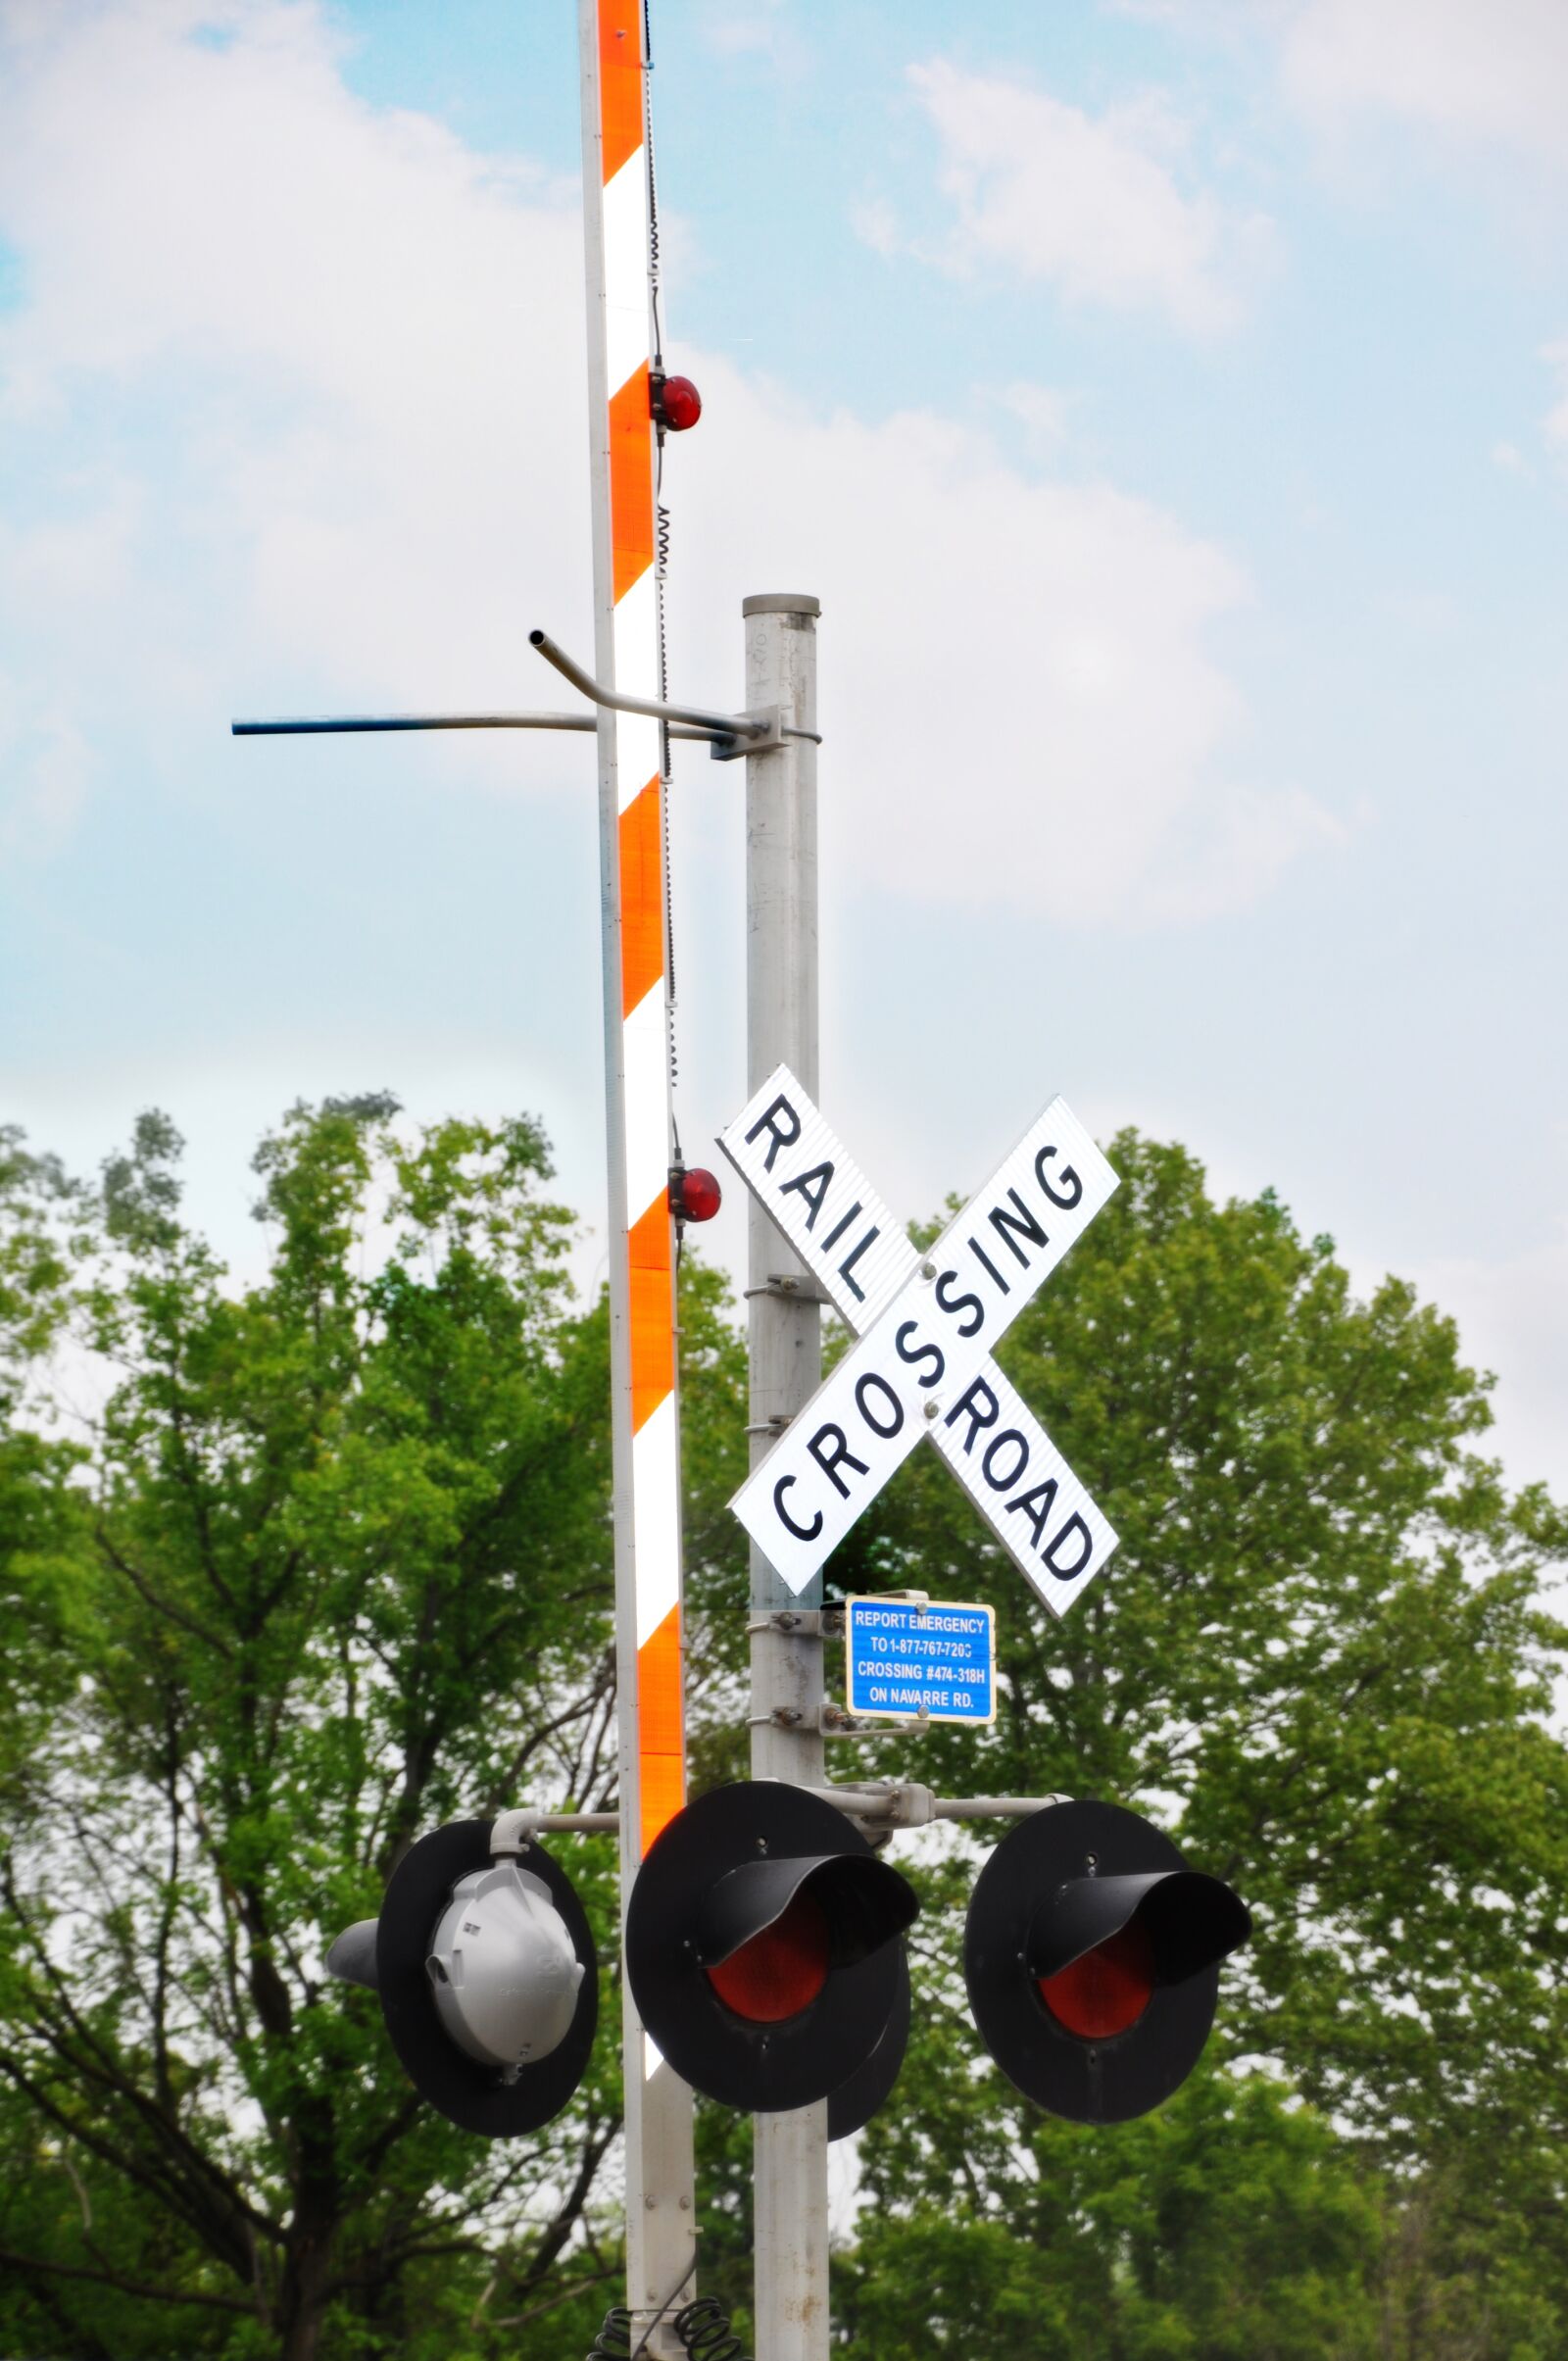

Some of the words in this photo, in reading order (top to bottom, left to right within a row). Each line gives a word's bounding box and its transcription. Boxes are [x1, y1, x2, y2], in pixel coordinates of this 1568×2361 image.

[744, 1093, 881, 1303] RAIL
[944, 1376, 1094, 1582] ROAD
[772, 1145, 1085, 1543] CROSSING
[856, 1610, 906, 1629] REPORT
[909, 1614, 985, 1634] EMERGENCY
[870, 1637, 888, 1651] TO
[858, 1661, 922, 1680] CROSSING
[926, 1665, 985, 1684] #474-318H
[869, 1687, 887, 1702] ON
[890, 1689, 949, 1706] NAVARRE
[953, 1694, 974, 1708] RD.
